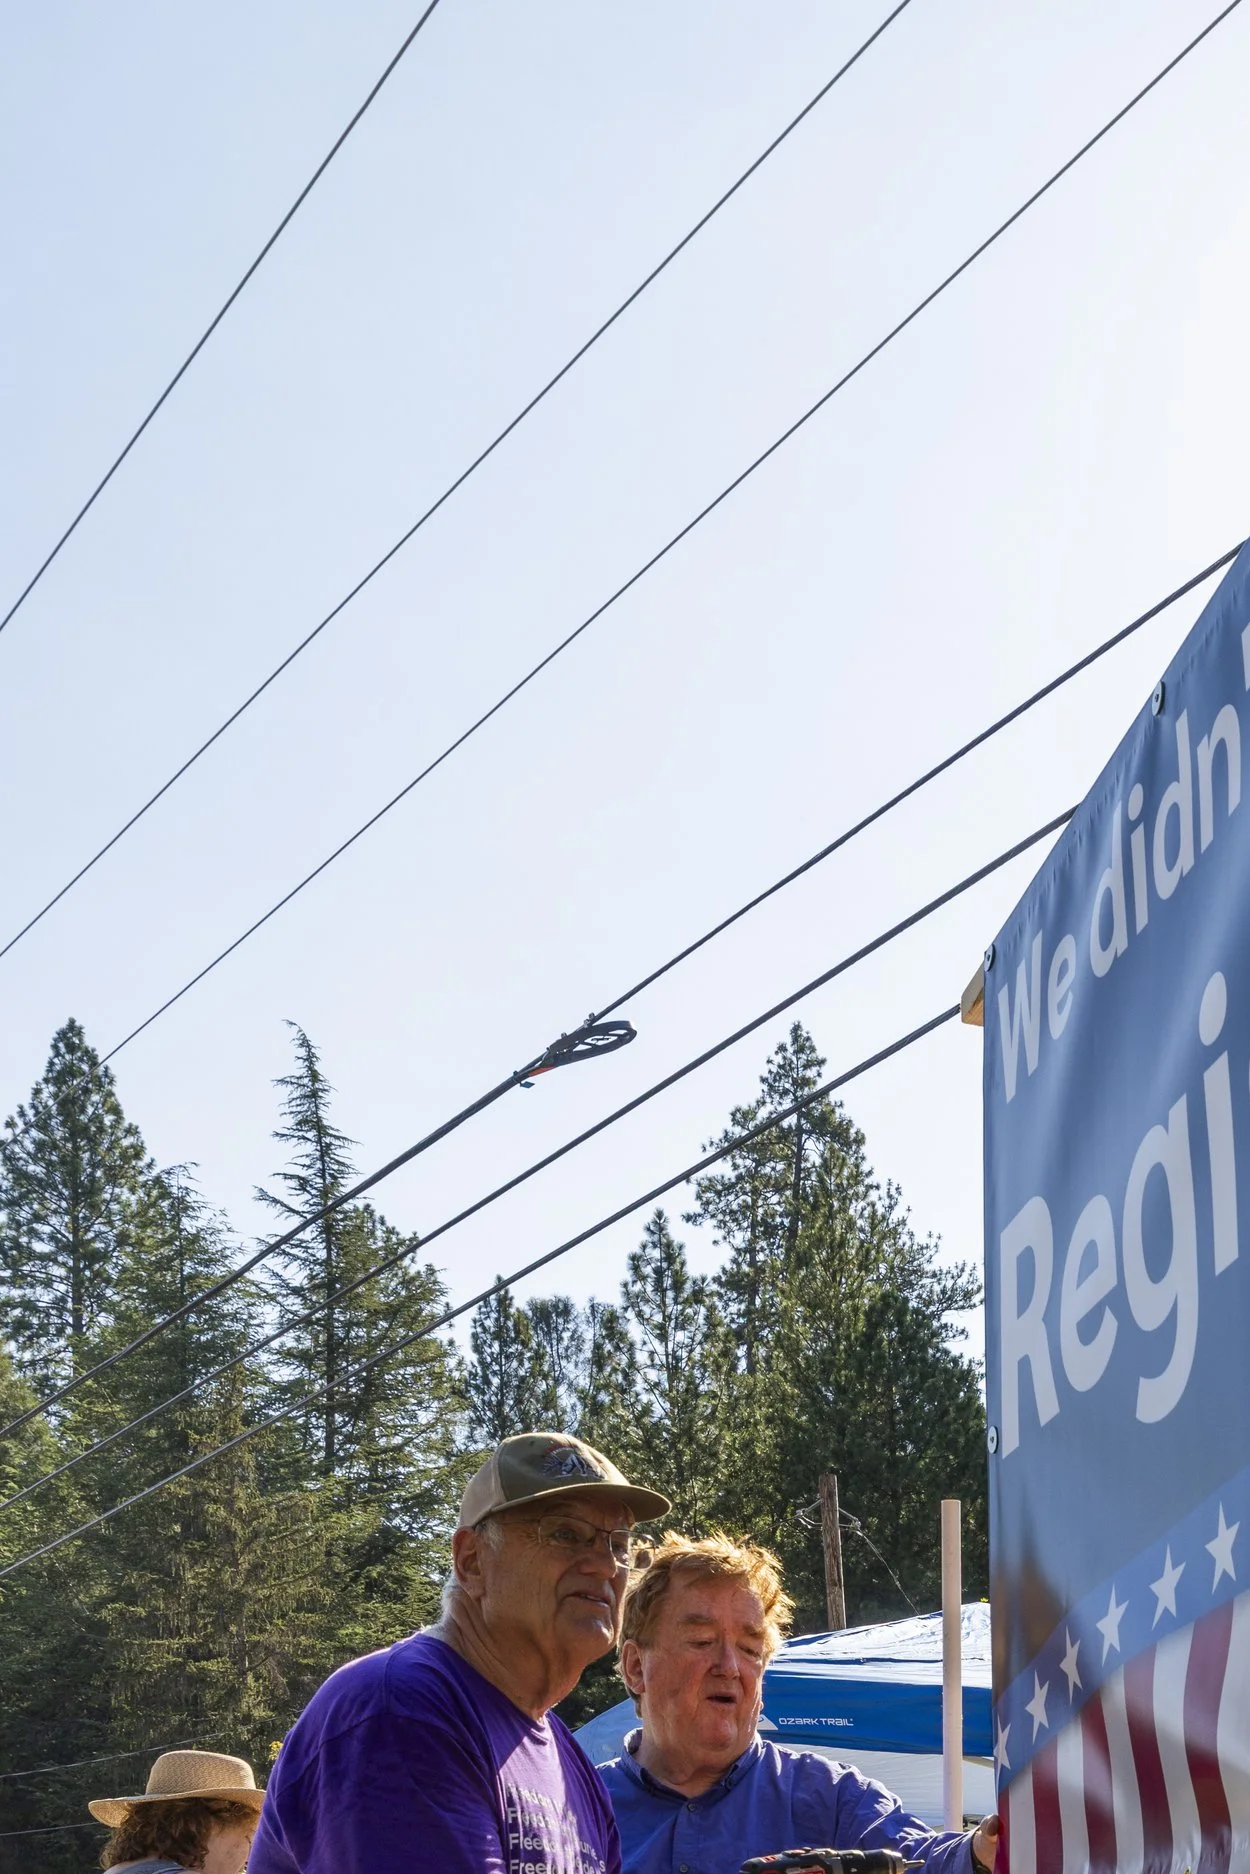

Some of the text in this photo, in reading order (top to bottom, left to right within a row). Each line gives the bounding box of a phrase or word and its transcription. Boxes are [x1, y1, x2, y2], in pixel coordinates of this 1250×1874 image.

[998, 928, 1076, 1104] We
[778, 1717, 854, 1726] OZARK TRAIL
